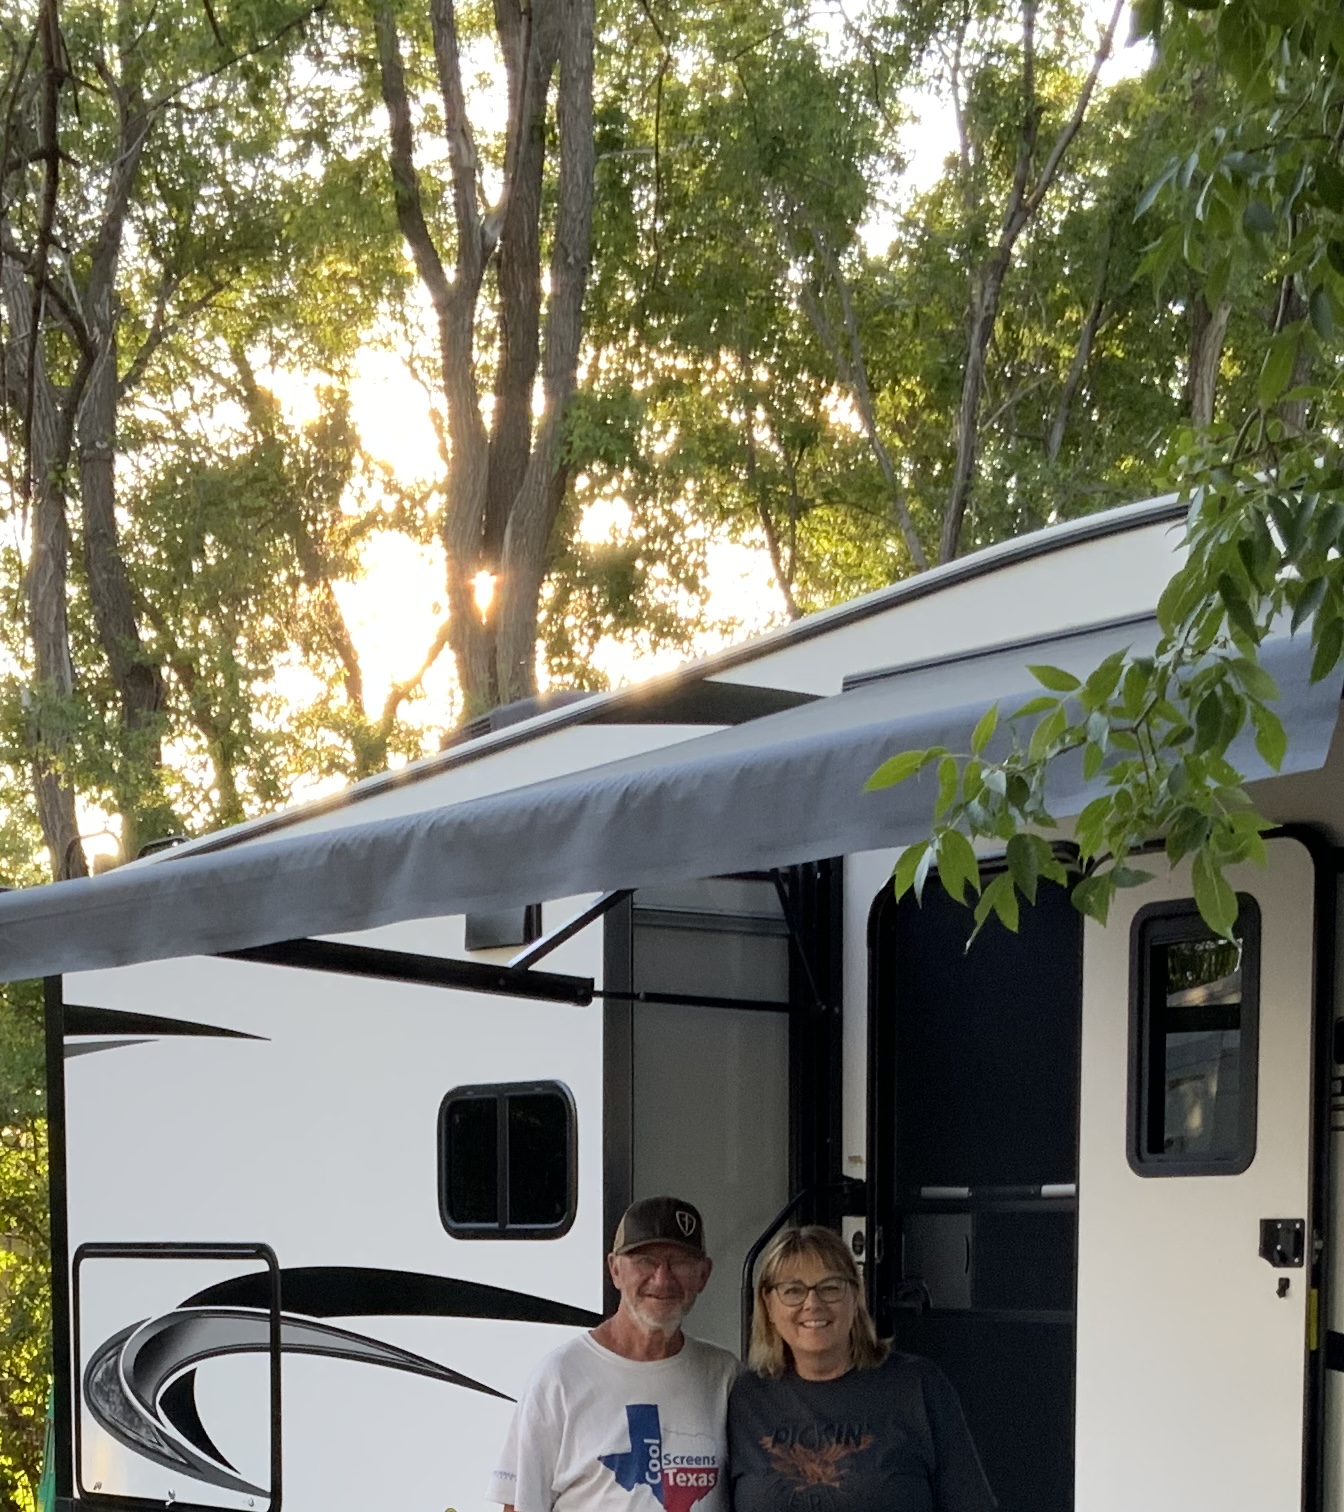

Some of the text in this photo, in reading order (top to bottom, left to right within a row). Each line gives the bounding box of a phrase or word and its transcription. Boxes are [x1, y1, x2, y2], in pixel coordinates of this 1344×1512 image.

[643, 1438, 662, 1485] Cool
[663, 1453, 716, 1466] Screens
[664, 1468, 716, 1487] Texas
